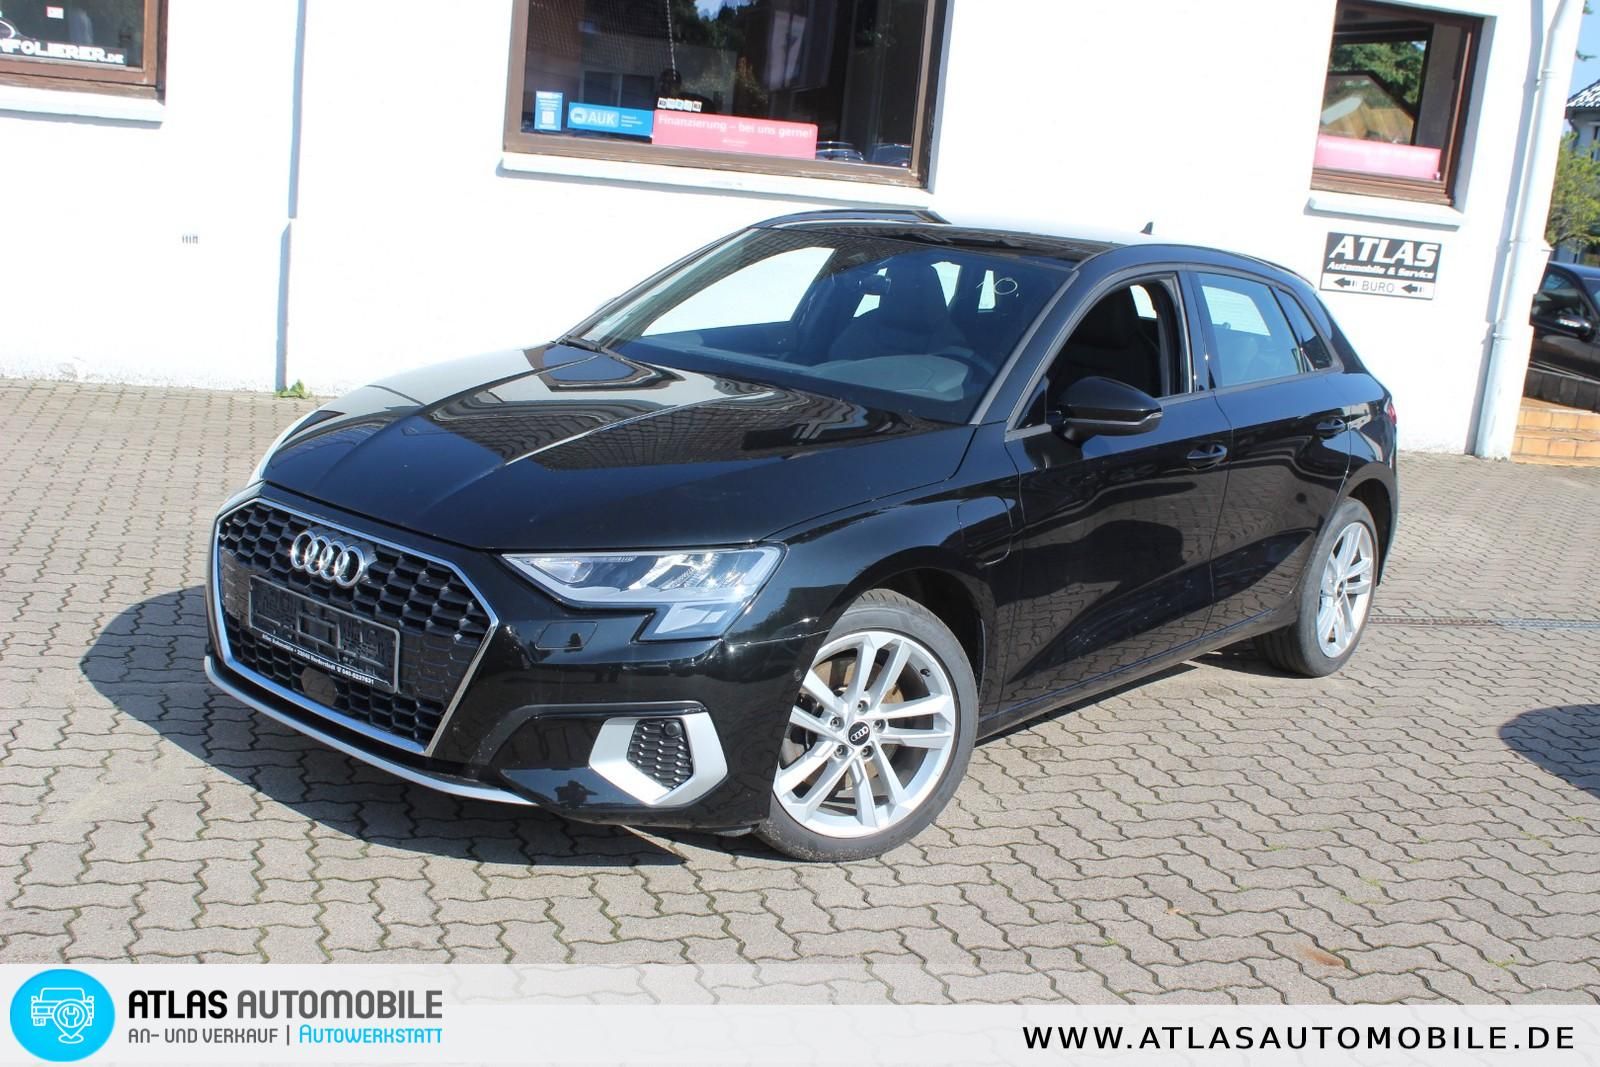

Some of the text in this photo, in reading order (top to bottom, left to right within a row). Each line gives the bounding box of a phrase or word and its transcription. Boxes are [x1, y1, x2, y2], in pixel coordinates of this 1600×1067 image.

[658, 115, 727, 130] Finanzierung
[738, 122, 756, 134] bei
[758, 125, 775, 135] uns
[778, 127, 813, 138] gerne!
[1328, 235, 1439, 268] ATLAS
[1326, 261, 1435, 279] Automobile & Service
